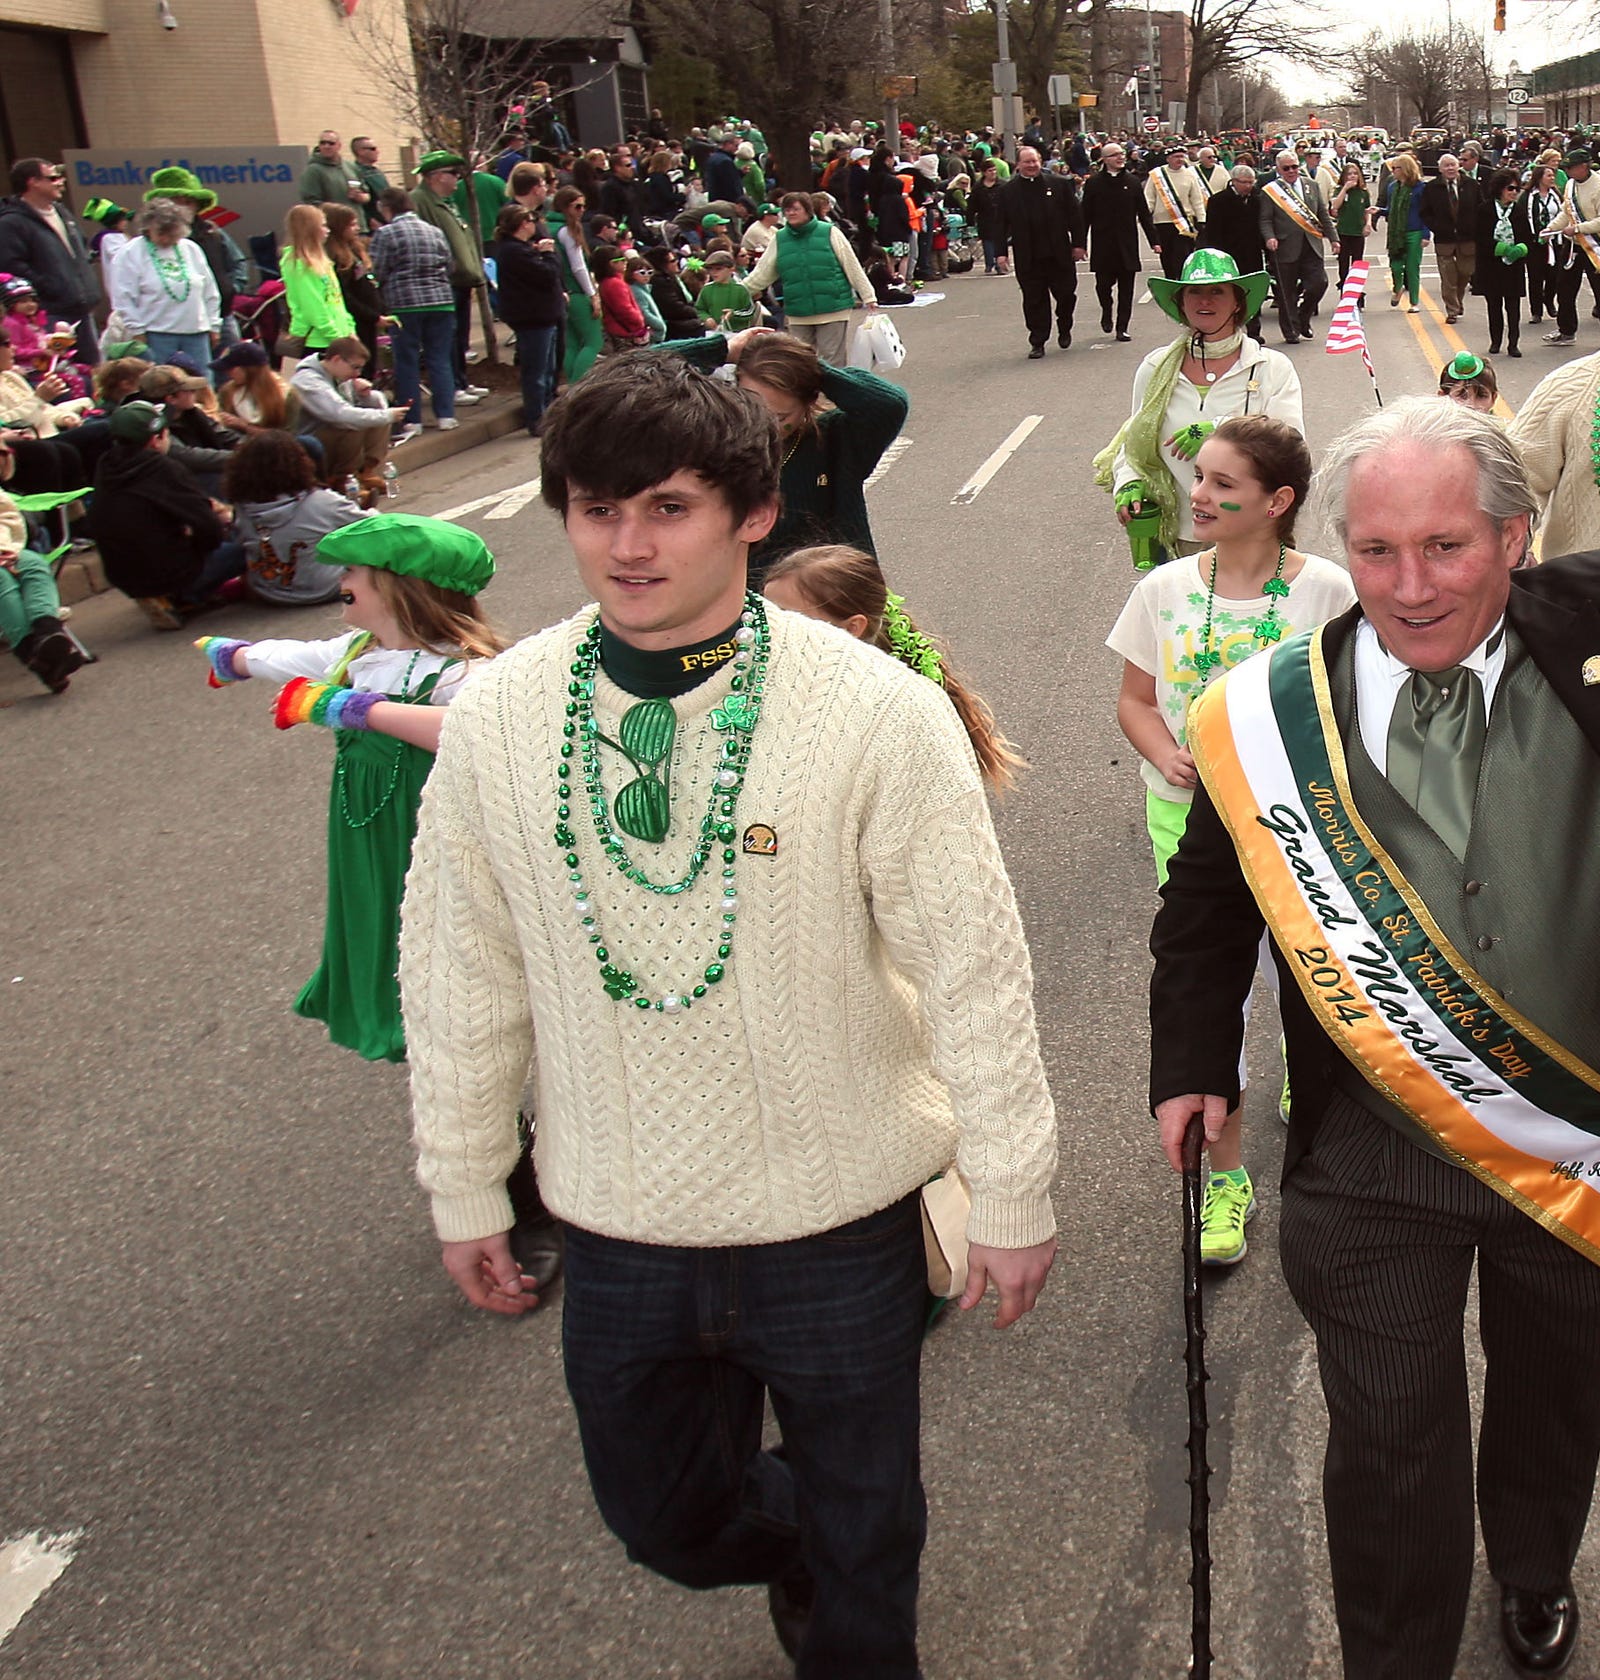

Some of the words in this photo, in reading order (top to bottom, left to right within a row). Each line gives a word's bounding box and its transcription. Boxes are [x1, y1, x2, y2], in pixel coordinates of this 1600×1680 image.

[1510, 91, 1527, 101] 124
[75, 159, 144, 186] Bank
[1256, 804, 1358, 931] Grand
[1347, 941, 1504, 1105] Marshal
[1307, 780, 1359, 867] Morris
[1354, 870, 1382, 909] Co.
[1382, 913, 1411, 947] St.
[1408, 946, 1490, 1042] Patrick's
[1488, 1036, 1533, 1080] Day
[1294, 947, 1370, 1027] 2014
[1550, 1160, 1584, 1181] Jeff
